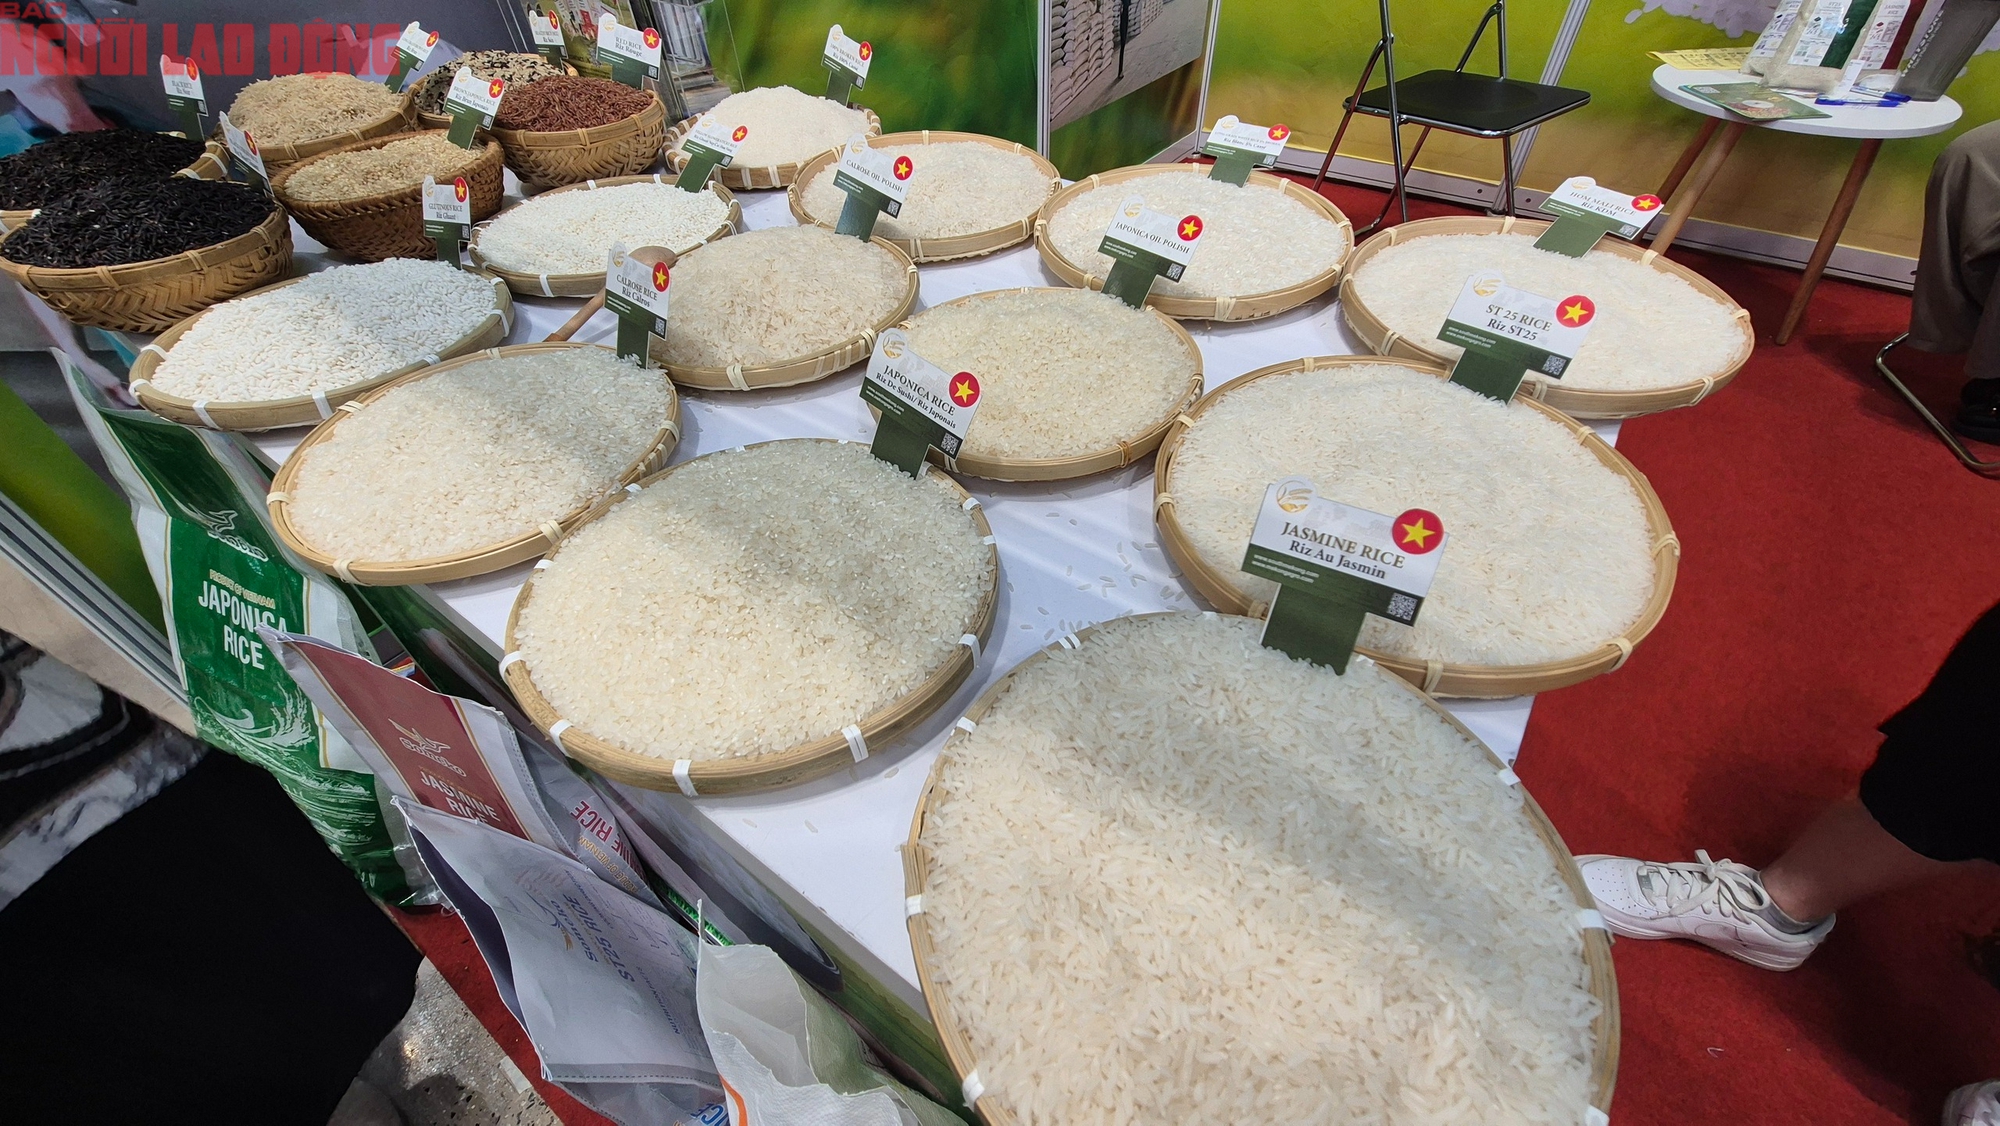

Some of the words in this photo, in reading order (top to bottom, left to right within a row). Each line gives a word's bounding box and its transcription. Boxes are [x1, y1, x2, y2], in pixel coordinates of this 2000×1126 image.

[615, 37, 628, 45] RED
[628, 40, 642, 50] RICE
[615, 42, 624, 50] Riz
[625, 46, 642, 57] Rouge
[846, 159, 870, 177] CALROSE
[870, 172, 881, 181] OIL
[881, 177, 903, 193] POLISH
[1569, 191, 1591, 202] HOM
[1592, 197, 1615, 209] MALI
[1615, 205, 1637, 216] RICE
[1581, 201, 1594, 209] Riz
[1595, 206, 1617, 217] KDM
[1115, 221, 1149, 239] JAPONICA
[1149, 234, 1162, 244] OIL
[1163, 239, 1190, 254] POLISH
[616, 274, 643, 294] CALROSE
[643, 287, 658, 301] RICE
[622, 286, 632, 298] Riz
[632, 292, 650, 308] Calros
[1486, 303, 1504, 317] ST
[1503, 310, 1517, 321] 25
[1520, 315, 1553, 332] RICE
[1487, 318, 1507, 332] Riz
[1507, 324, 1539, 342] ST25
[876, 372, 887, 384] Riz
[887, 379, 897, 391] De
[897, 385, 918, 403] Sushi/
[917, 399, 929, 412] Riz
[929, 406, 956, 429] Japonais
[883, 365, 931, 401] JAPONICA
[931, 393, 956, 416] RICE
[1281, 521, 1358, 555] JASMINE
[1360, 544, 1406, 569] RICE
[1289, 540, 1312, 557] Riz
[1315, 550, 1335, 564] Au
[1335, 555, 1386, 579] Jasmin
[198, 580, 288, 634] JAPONICA
[223, 624, 265, 670] RICE
[420, 771, 501, 822] JASMINE
[570, 800, 613, 843] RICE
[551, 900, 599, 963] Someko
[563, 893, 603, 933] RICE
[595, 936, 636, 982] ST25
